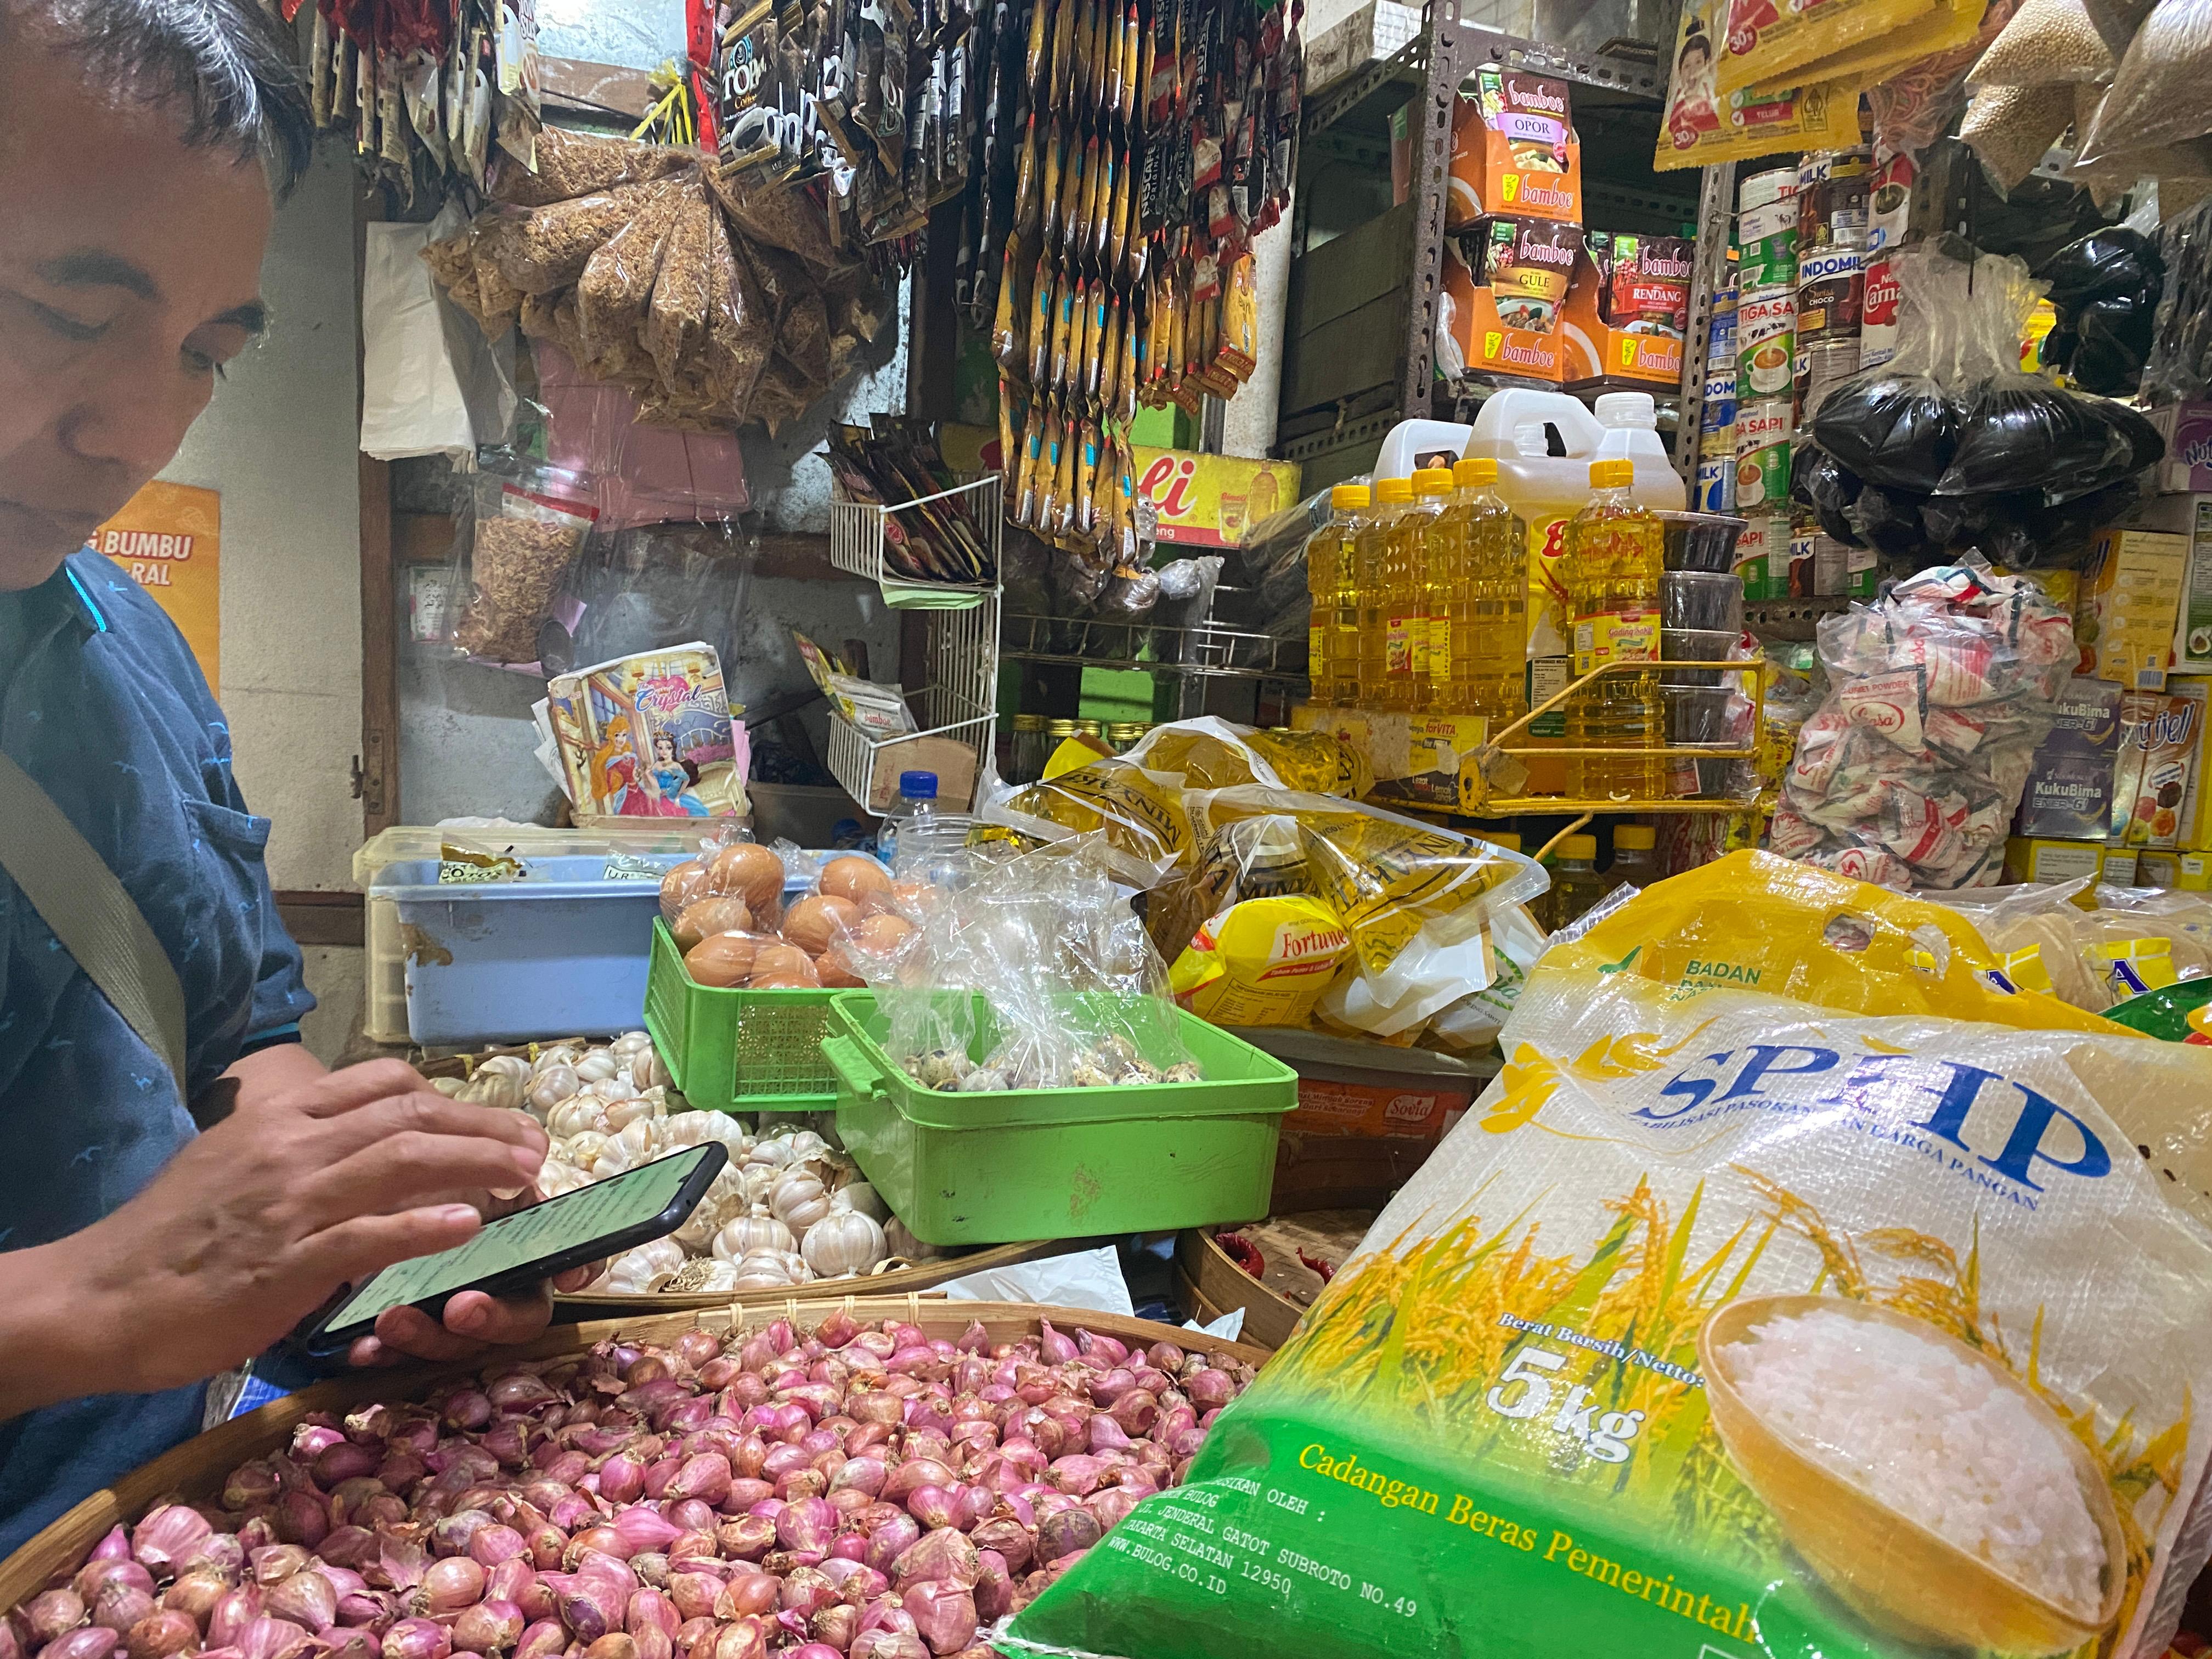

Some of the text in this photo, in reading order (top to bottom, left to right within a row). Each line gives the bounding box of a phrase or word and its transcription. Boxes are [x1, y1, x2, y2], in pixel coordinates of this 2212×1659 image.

[1509, 80, 1565, 112] bamboe
[1515, 119, 1550, 134] OPOR
[1521, 173, 1573, 209] bamboe
[1520, 229, 1574, 267] bamboe
[1519, 274, 1550, 288] GULE
[1633, 288, 1681, 302] RENDANG
[1809, 296, 1834, 306] CHOCO
[1740, 302, 1797, 323] TIGA SA
[1502, 332, 1554, 368] bamboe
[1748, 417, 1784, 434] SAPI
[104, 531, 192, 560] BUMBU
[128, 562, 171, 585] RAL
[1872, 680, 1910, 690] POWDER
[635, 684, 702, 713] Crystal
[2058, 702, 2110, 719] kuBima
[1426, 722, 1456, 736] forVITA
[2035, 781, 2102, 799] KukuBima
[1282, 929, 1347, 958] Fortune
[1686, 960, 1762, 985] BADAN
[1390, 1098, 1429, 1116] Sovia
[1949, 1158, 2039, 1211] PANGAN
[1497, 1312, 1555, 1338] Berat
[1182, 1489, 1220, 1509] BULOG
[1267, 1489, 1309, 1515] OLEH
[1299, 1442, 1757, 1645] Cadangan Beras Pemerintah
[1121, 1519, 1293, 1595] JAKARTA SELATAN 12950
[1158, 1505, 1215, 1534] JENDERAL
[1222, 1526, 1271, 1557] GATOT
[1277, 1549, 1352, 1590] SUBROTO
[1360, 1582, 1418, 1618] NO.49
